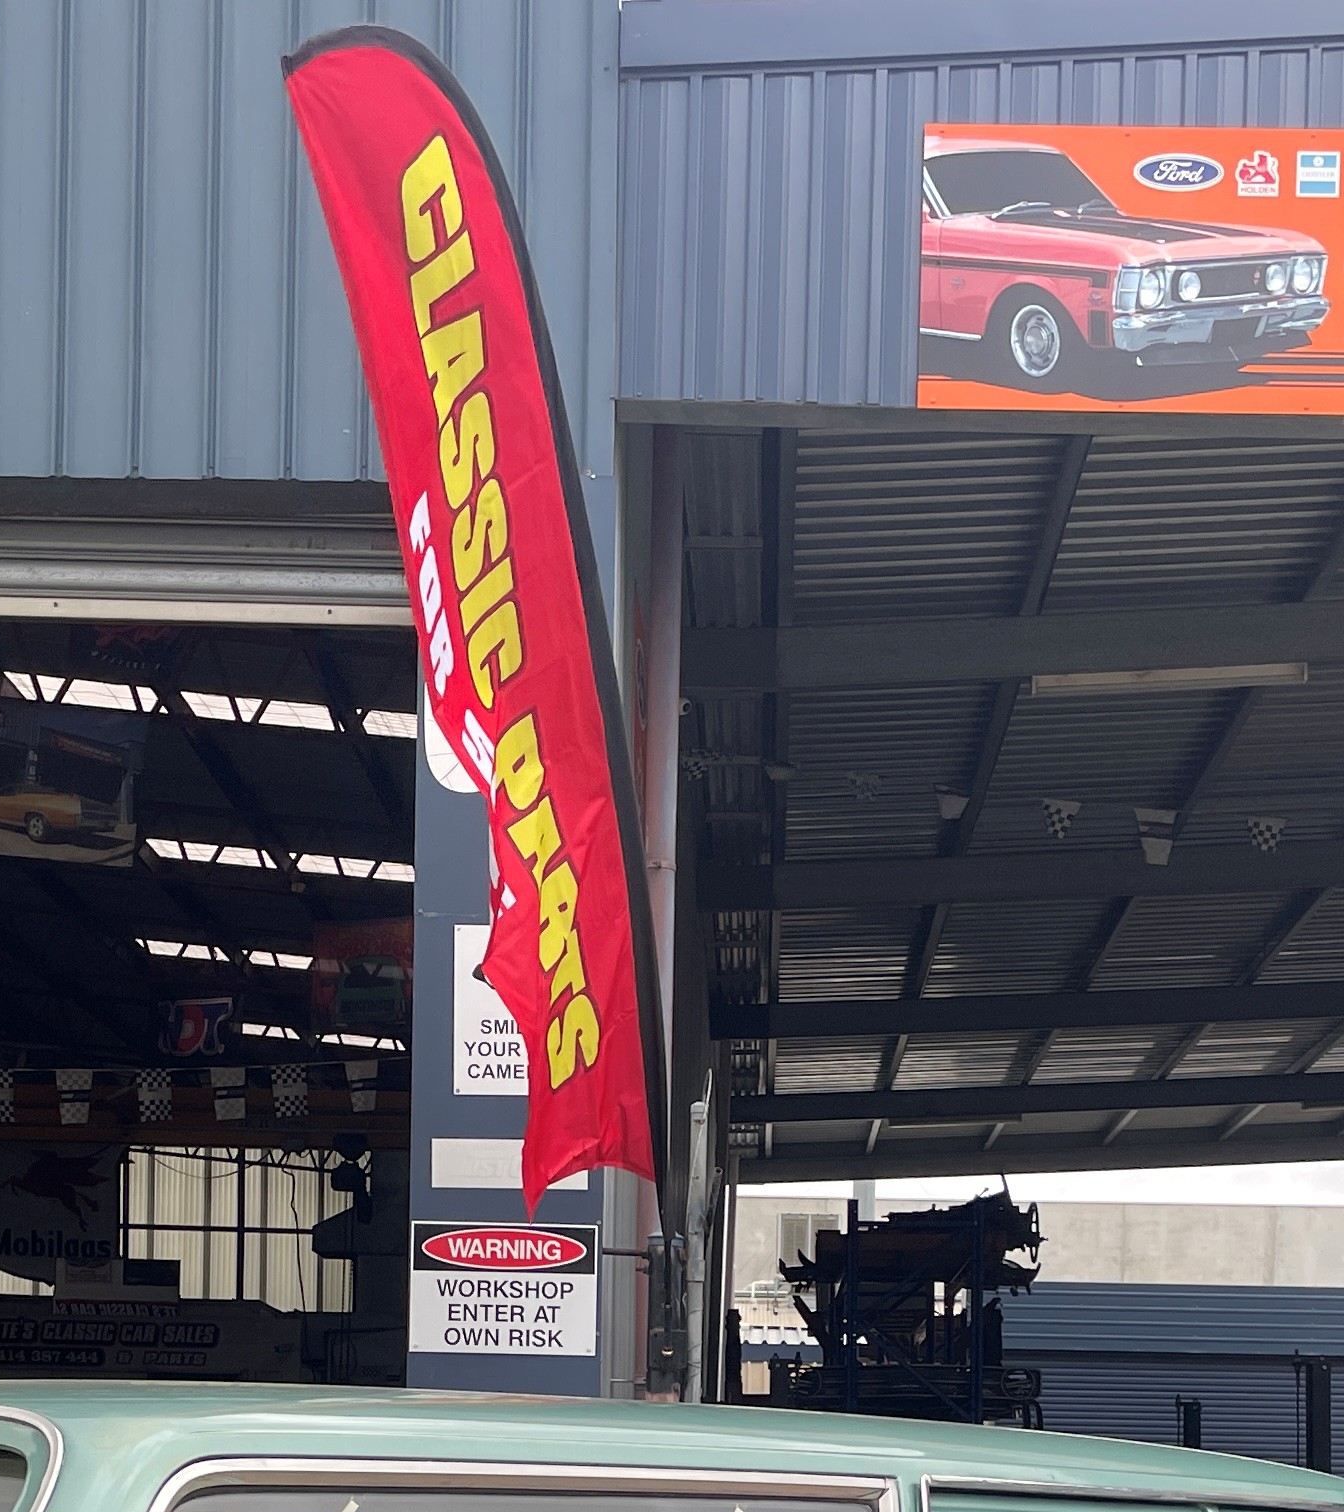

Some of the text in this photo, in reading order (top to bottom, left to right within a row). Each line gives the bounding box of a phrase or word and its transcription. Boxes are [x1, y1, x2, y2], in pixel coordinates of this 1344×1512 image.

[1153, 160, 1205, 183] Ford
[1240, 186, 1277, 194] HOLDEN
[408, 490, 455, 699] FOR
[401, 134, 522, 709] CLASSIC
[493, 711, 601, 1090] PARTS
[480, 1019, 523, 1035] SMIL
[464, 1041, 521, 1057] YOUR
[467, 1063, 530, 1079] CAME
[447, 1236, 562, 1262] WARNING
[437, 1278, 574, 1300] WORKSHOP
[448, 1303, 561, 1324] ENTER AT
[43, 1321, 116, 1343] CLASSIC
[120, 1323, 157, 1343] CAR
[163, 1324, 215, 1344] SALES
[443, 1328, 564, 1348] OWN RISK
[30, 1349, 61, 1363] 387
[65, 1350, 99, 1364] 444
[144, 1352, 207, 1366] PARTS
